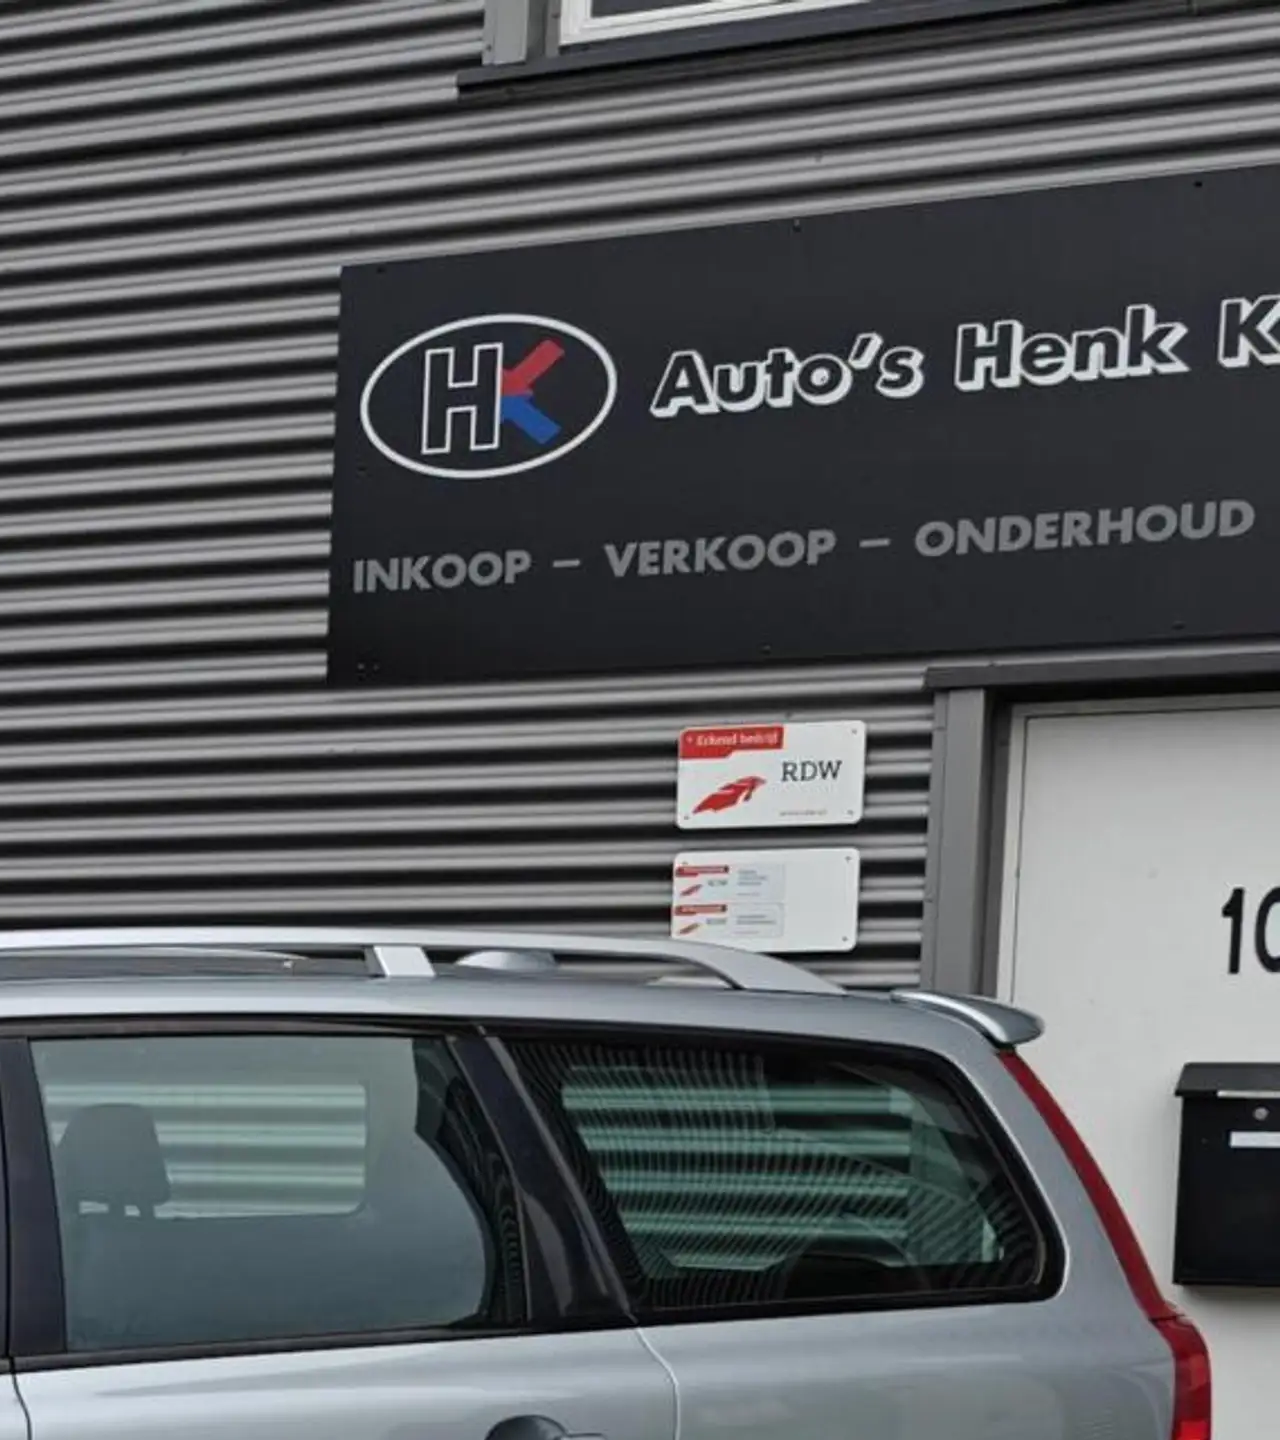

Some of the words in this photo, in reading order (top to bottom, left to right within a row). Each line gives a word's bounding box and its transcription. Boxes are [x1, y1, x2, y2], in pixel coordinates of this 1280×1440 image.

[650, 332, 924, 418] Auto's
[955, 303, 1191, 391] Henk
[353, 548, 532, 594] INKOOP
[604, 528, 836, 579] VERKOOP
[914, 500, 1256, 558] ONDERHOUD
[781, 760, 842, 782] RDW
